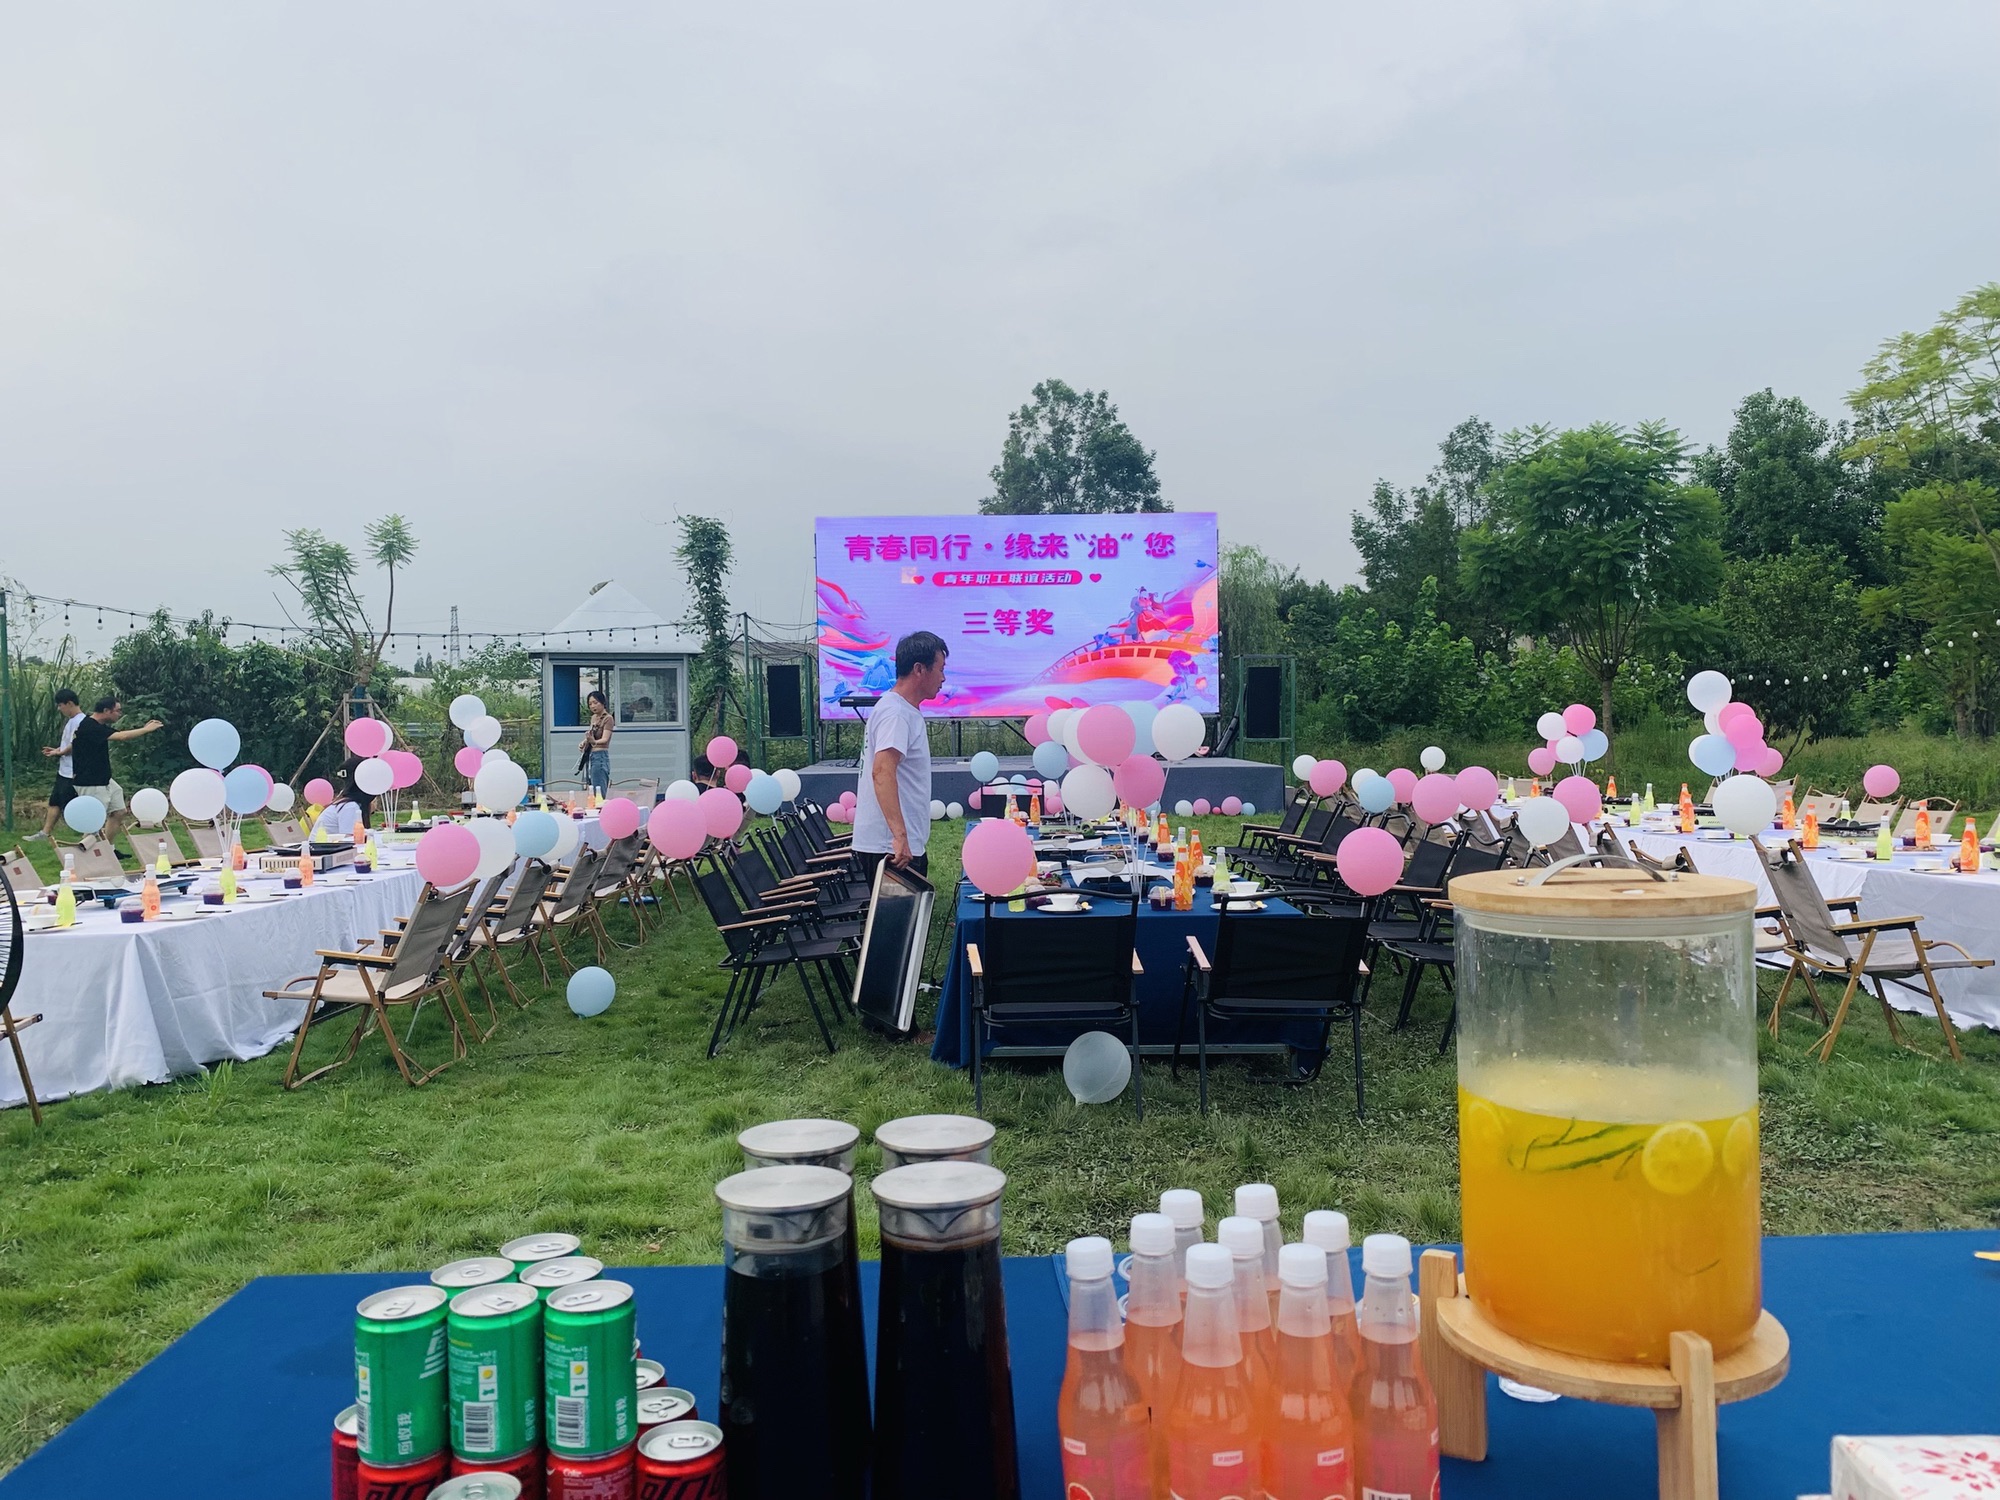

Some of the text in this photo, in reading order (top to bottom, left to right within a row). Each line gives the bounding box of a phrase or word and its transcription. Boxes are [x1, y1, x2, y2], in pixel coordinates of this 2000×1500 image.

[943, 572, 1073, 585] 青年职工联谊活动
[962, 608, 1054, 636] 三等奖
